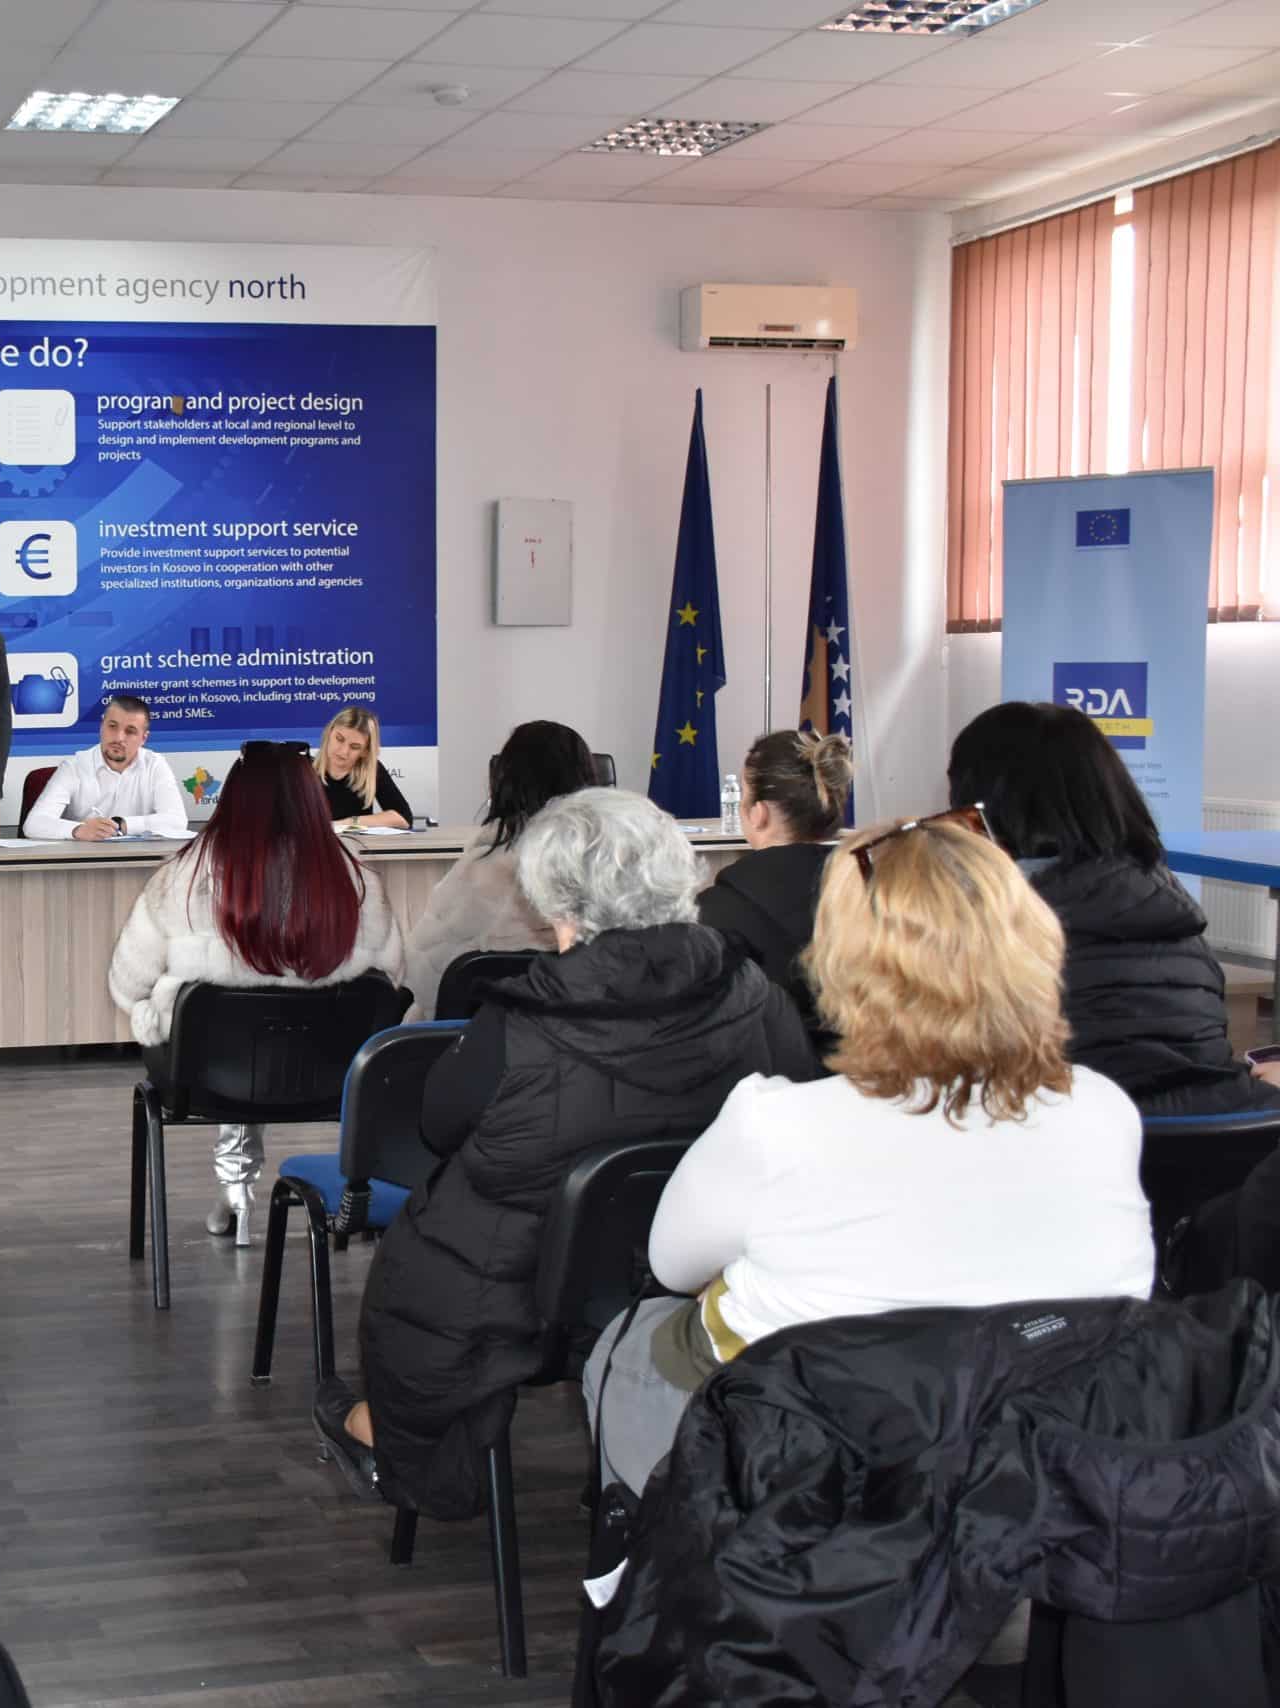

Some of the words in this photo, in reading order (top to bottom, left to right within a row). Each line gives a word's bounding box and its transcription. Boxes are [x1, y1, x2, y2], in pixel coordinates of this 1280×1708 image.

[115, 278, 219, 305] agency
[229, 274, 306, 300] north
[29, 337, 88, 369] do?
[187, 393, 222, 410] and
[228, 393, 295, 413] project
[300, 393, 363, 414] design
[98, 420, 141, 431] Support
[144, 419, 210, 430] stakeholders
[212, 421, 223, 429] at
[225, 420, 249, 430] local
[252, 420, 271, 430] and
[274, 420, 316, 432] regional
[318, 420, 342, 430] level
[344, 422, 355, 430] to
[98, 435, 133, 447] design
[136, 435, 156, 445] and
[159, 435, 216, 447] implement
[219, 435, 287, 447] development
[290, 436, 338, 447] programs
[341, 436, 361, 446] and
[98, 450, 141, 462] projects
[99, 521, 207, 536] investment
[213, 521, 288, 540] support
[293, 520, 358, 536] service
[101, 548, 140, 558] Provide
[142, 548, 201, 557] investment
[204, 548, 245, 559] support
[248, 548, 288, 557] services
[290, 548, 301, 556] to
[304, 546, 349, 558] potential
[101, 563, 148, 573] investors
[150, 563, 160, 572] in
[163, 563, 201, 572] Kosovo
[203, 563, 213, 572] in
[216, 563, 279, 574] cooperation
[281, 562, 304, 571] with
[306, 562, 333, 571] other
[101, 578, 158, 590] specialized
[161, 578, 221, 589] institutions,
[224, 577, 294, 590] organizations
[297, 577, 315, 586] and
[318, 577, 362, 589] agencies
[101, 653, 154, 673] grant
[158, 650, 231, 668] scheme
[237, 649, 373, 666] administration
[102, 679, 158, 689] Administer
[162, 679, 188, 691] grant
[191, 677, 236, 688] schemes
[239, 678, 248, 687] in
[251, 677, 291, 689] support
[294, 676, 304, 685] to
[307, 675, 375, 687] development
[154, 691, 186, 703] sector
[189, 692, 198, 703] in
[201, 691, 240, 703] Kosovo,
[243, 690, 291, 704] including
[294, 689, 340, 702] strat-ups,
[343, 690, 375, 702] young
[1065, 688, 1133, 715] RDA
[163, 708, 182, 718] and
[185, 707, 215, 718] SMEs.
